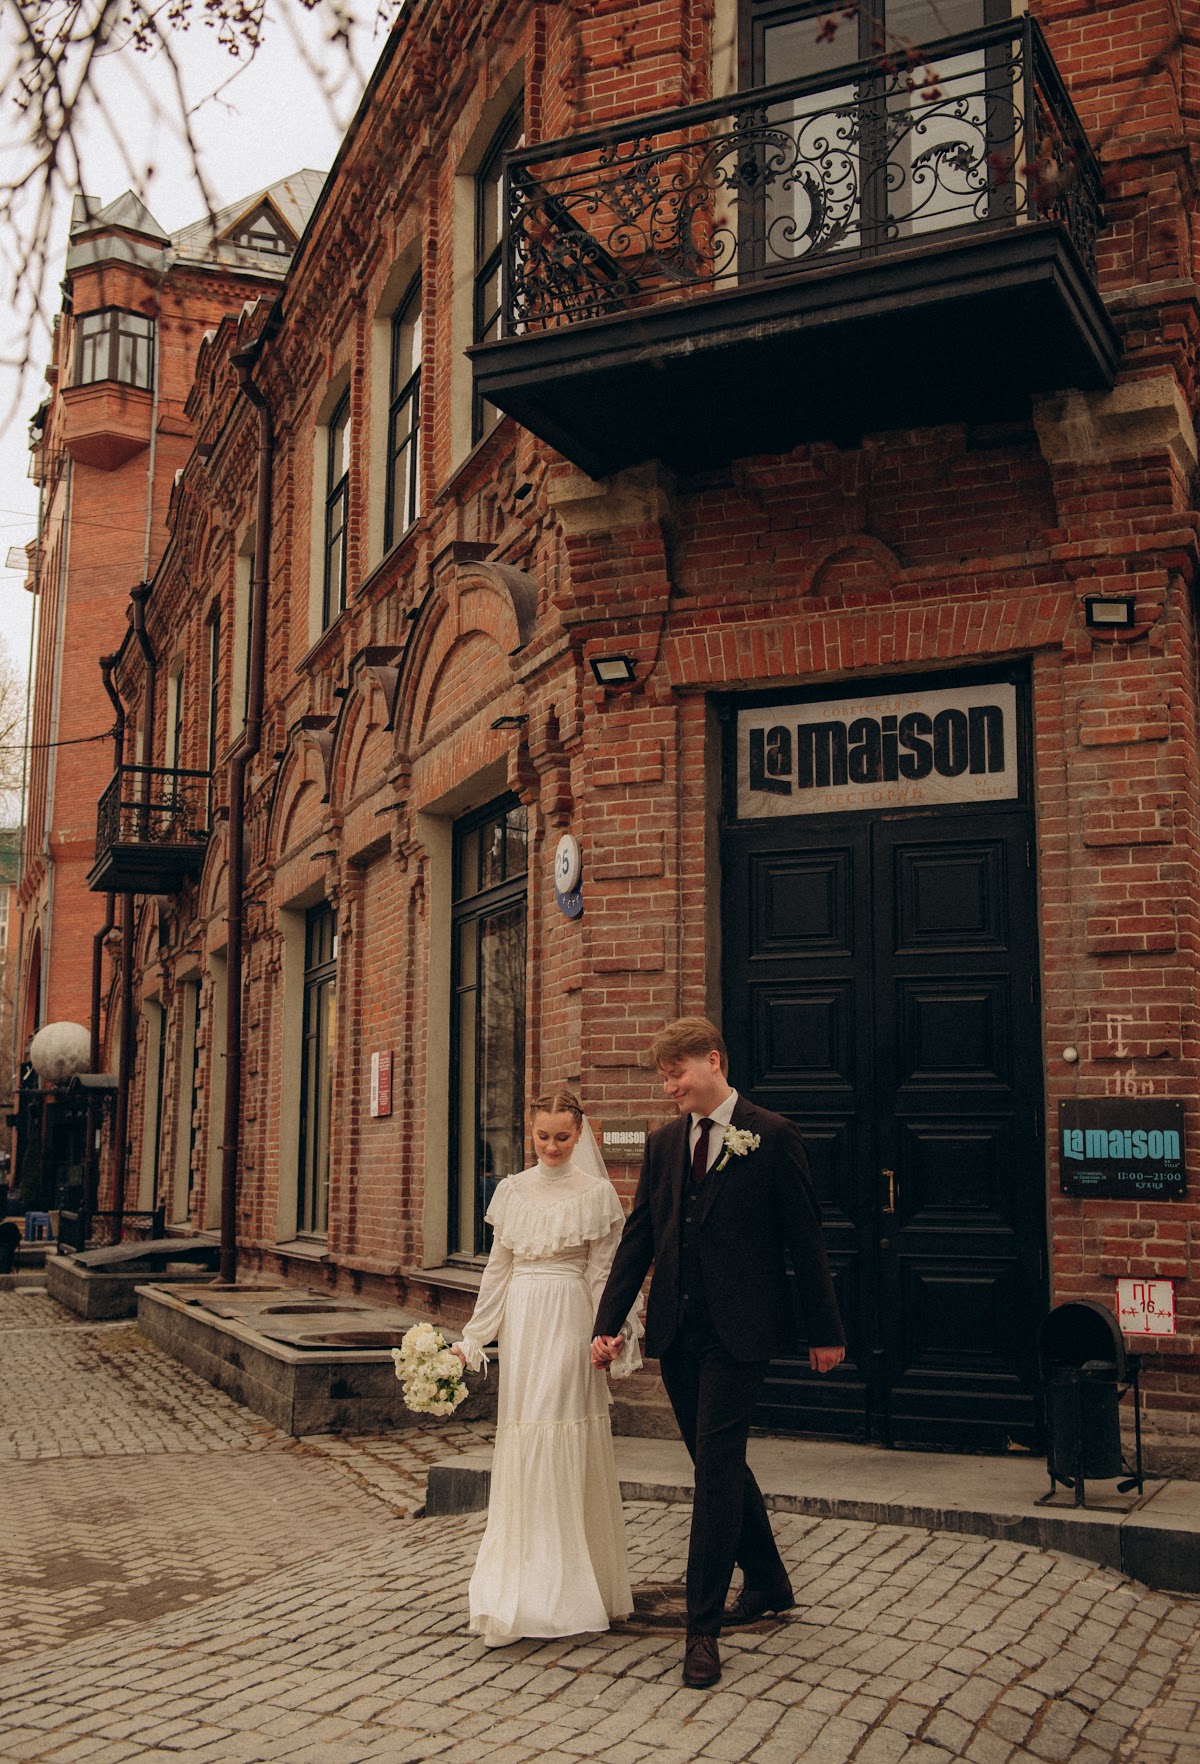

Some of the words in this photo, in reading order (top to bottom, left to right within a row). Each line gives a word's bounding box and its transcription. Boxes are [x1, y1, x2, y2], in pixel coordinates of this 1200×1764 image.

[823, 786, 923, 806] РЕСТОРАН
[1133, 1284, 1156, 1301] ПГ
[1140, 1300, 1155, 1313] 16
